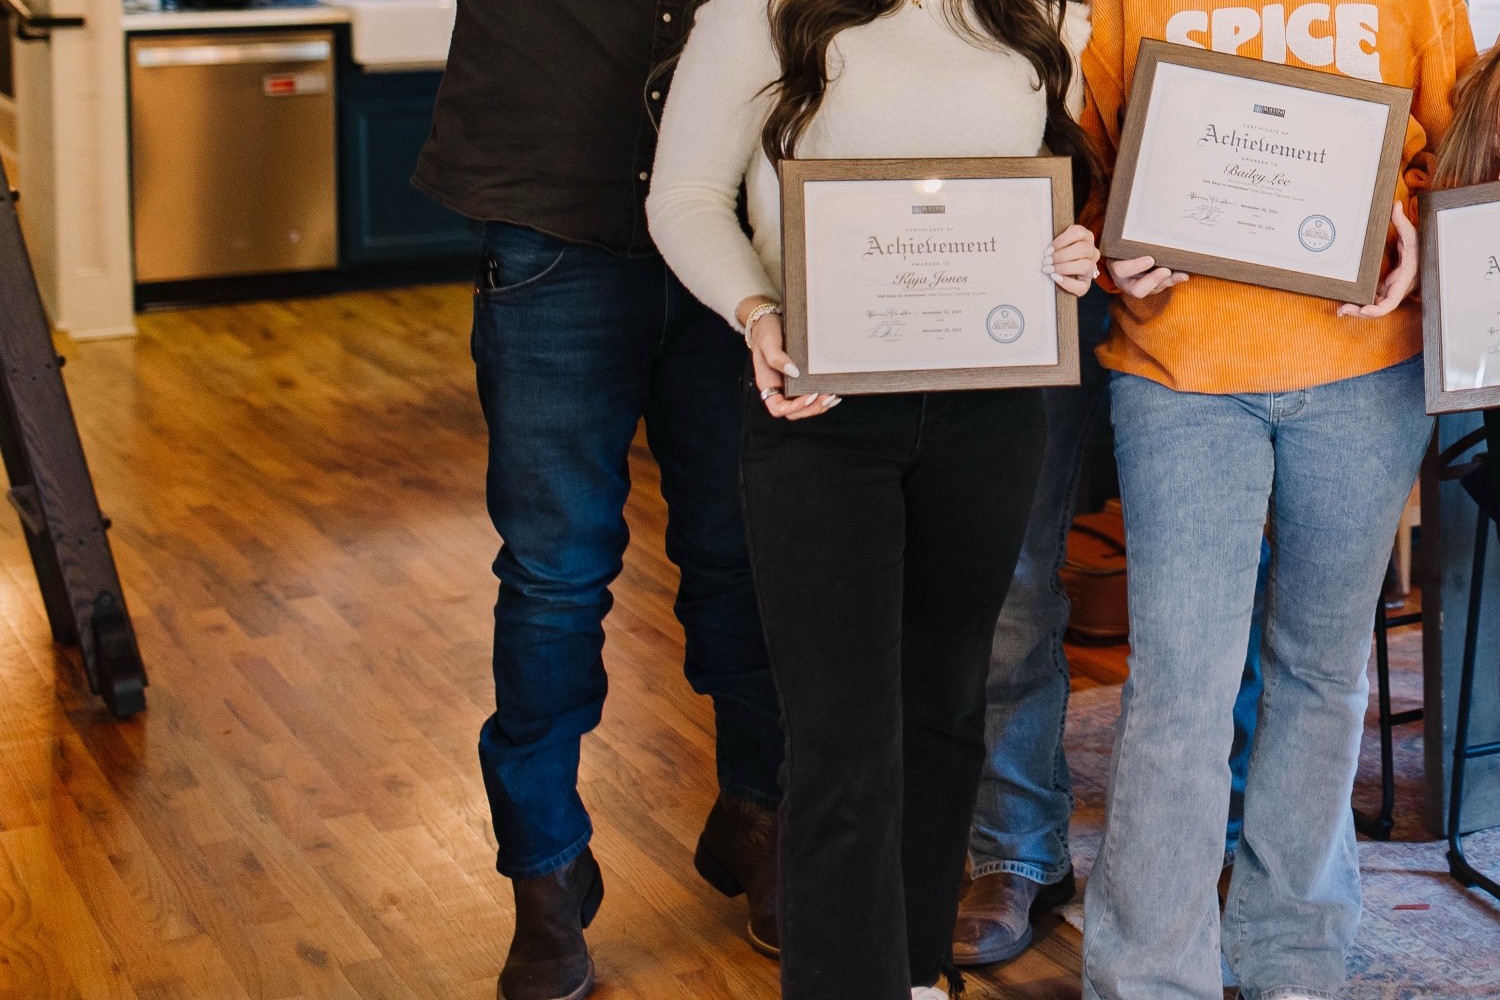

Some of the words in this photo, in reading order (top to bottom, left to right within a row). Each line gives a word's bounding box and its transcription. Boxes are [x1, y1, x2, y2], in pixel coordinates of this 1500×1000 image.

[1166, 3, 1383, 83] SPICE
[1197, 123, 1327, 164] Achievement
[1223, 163, 1266, 184] Bailey
[1266, 172, 1291, 186] Lee
[862, 235, 998, 261] Achievement
[893, 271, 927, 289] Kiya
[928, 270, 969, 288] Jones
